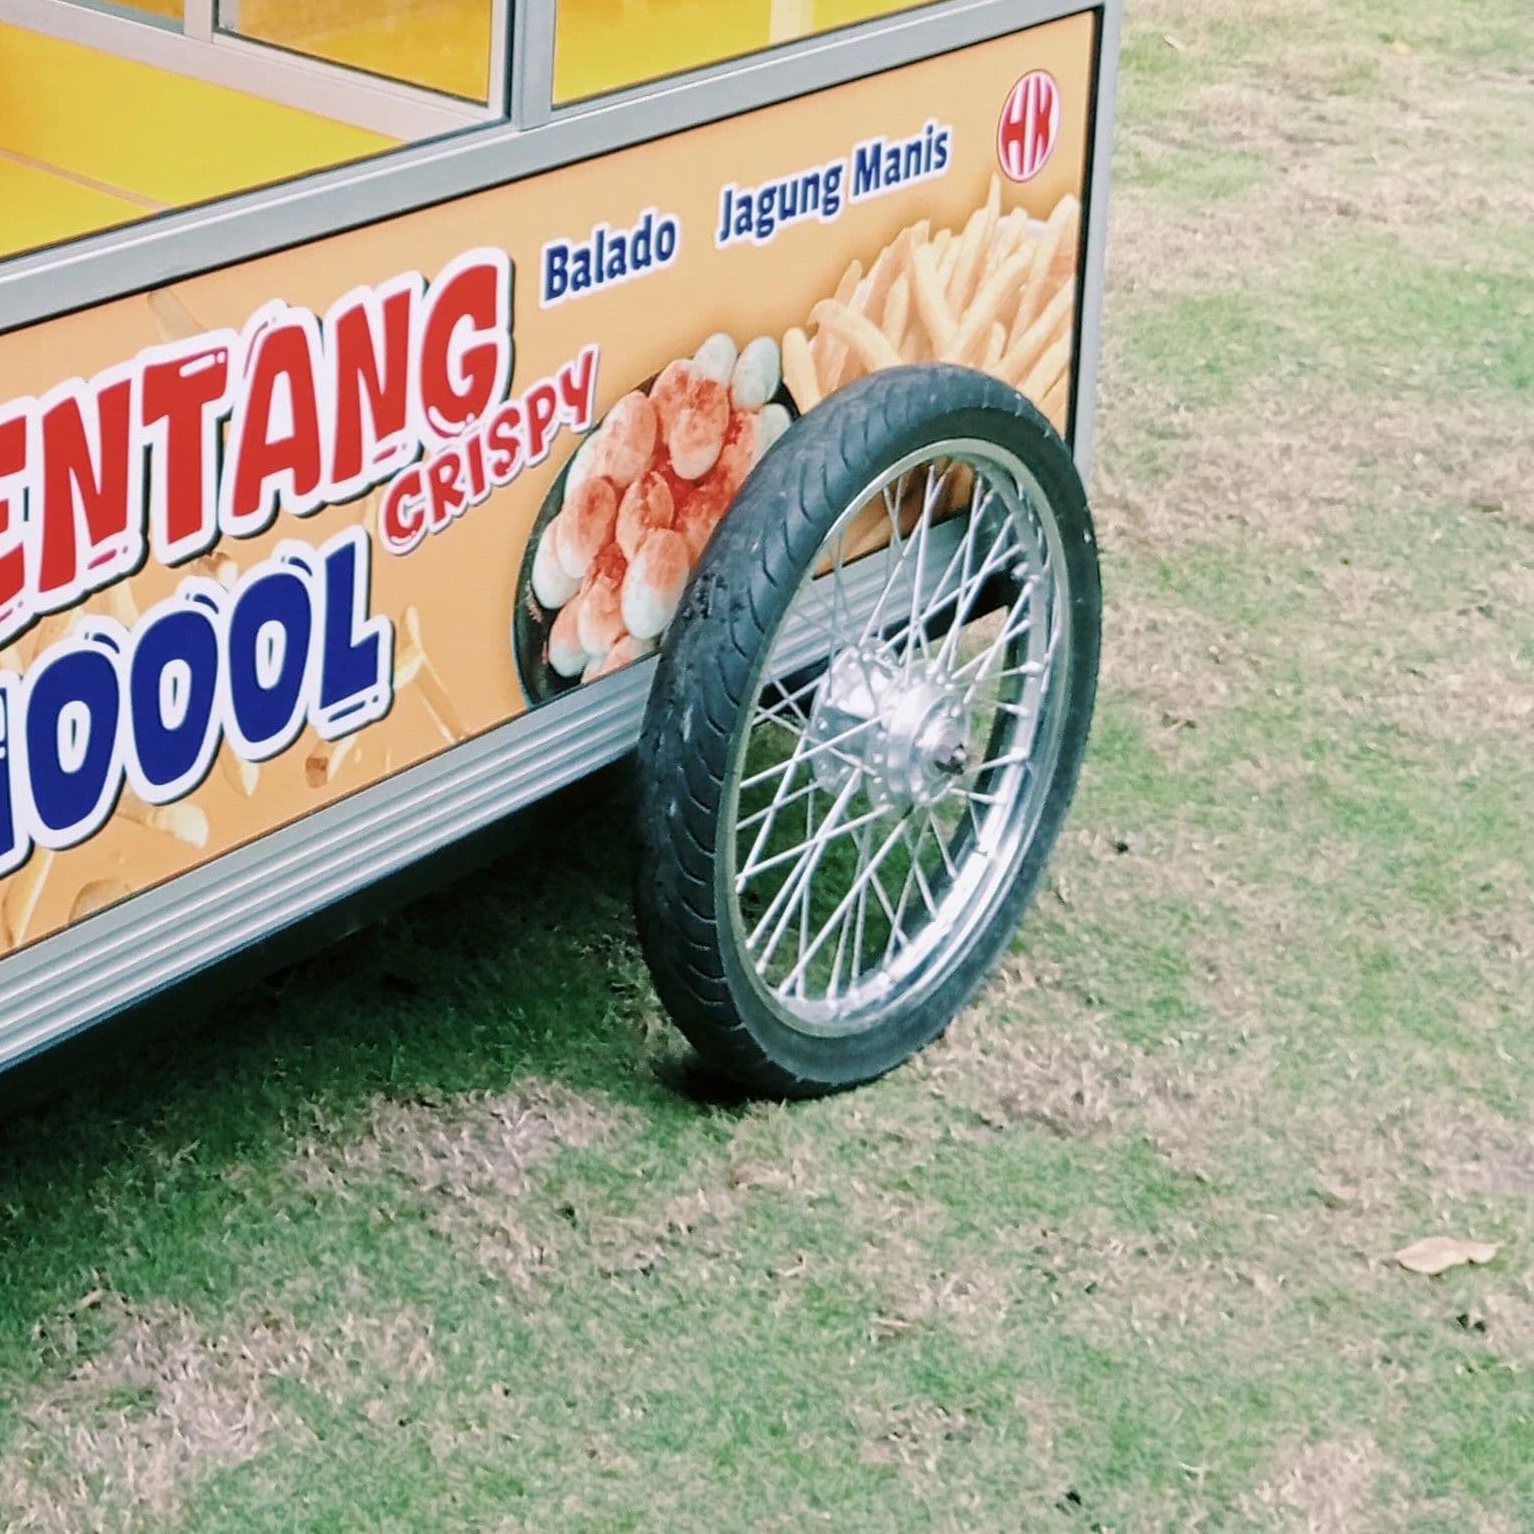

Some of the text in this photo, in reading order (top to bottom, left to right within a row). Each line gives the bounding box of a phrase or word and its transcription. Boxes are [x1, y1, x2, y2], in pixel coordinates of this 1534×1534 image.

[545, 124, 949, 301] Balado Jagung Manis
[381, 348, 598, 548] CRISPY
